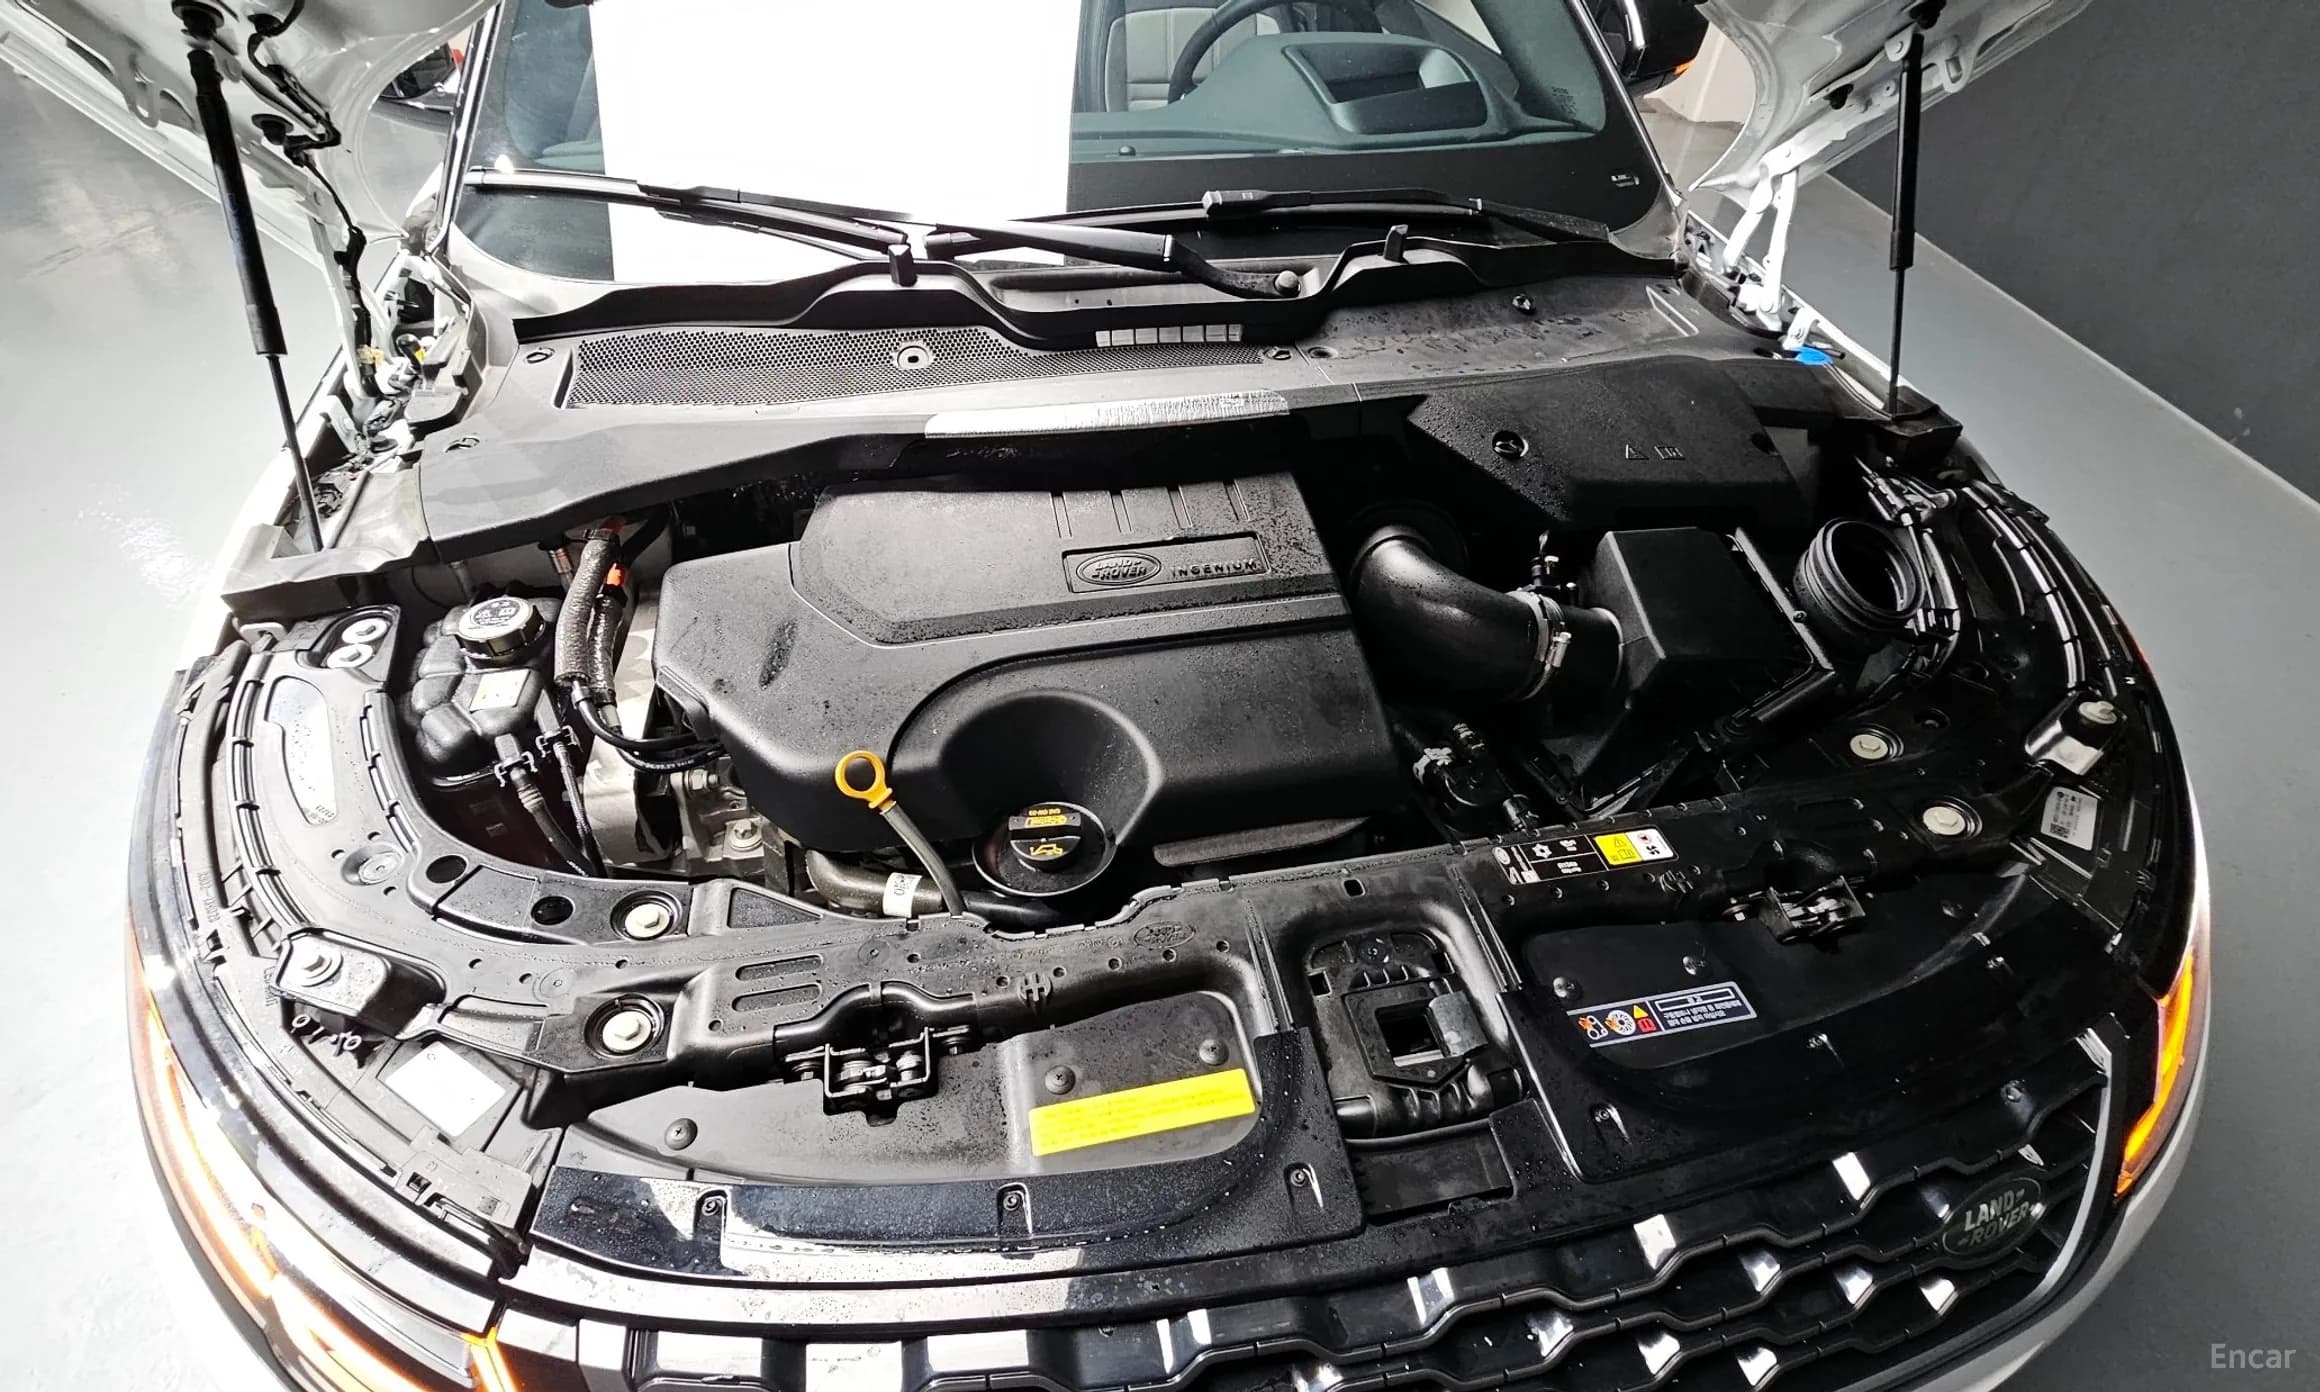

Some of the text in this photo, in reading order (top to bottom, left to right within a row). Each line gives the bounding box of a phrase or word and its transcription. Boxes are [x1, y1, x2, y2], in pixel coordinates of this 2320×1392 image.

[1095, 559, 1135, 571] LAND
[1100, 566, 1148, 580] ROVER
[1170, 559, 1258, 578] INGENIUM
[1964, 1190, 2014, 1231] LAND
[1970, 1201, 2030, 1246] ROVER
